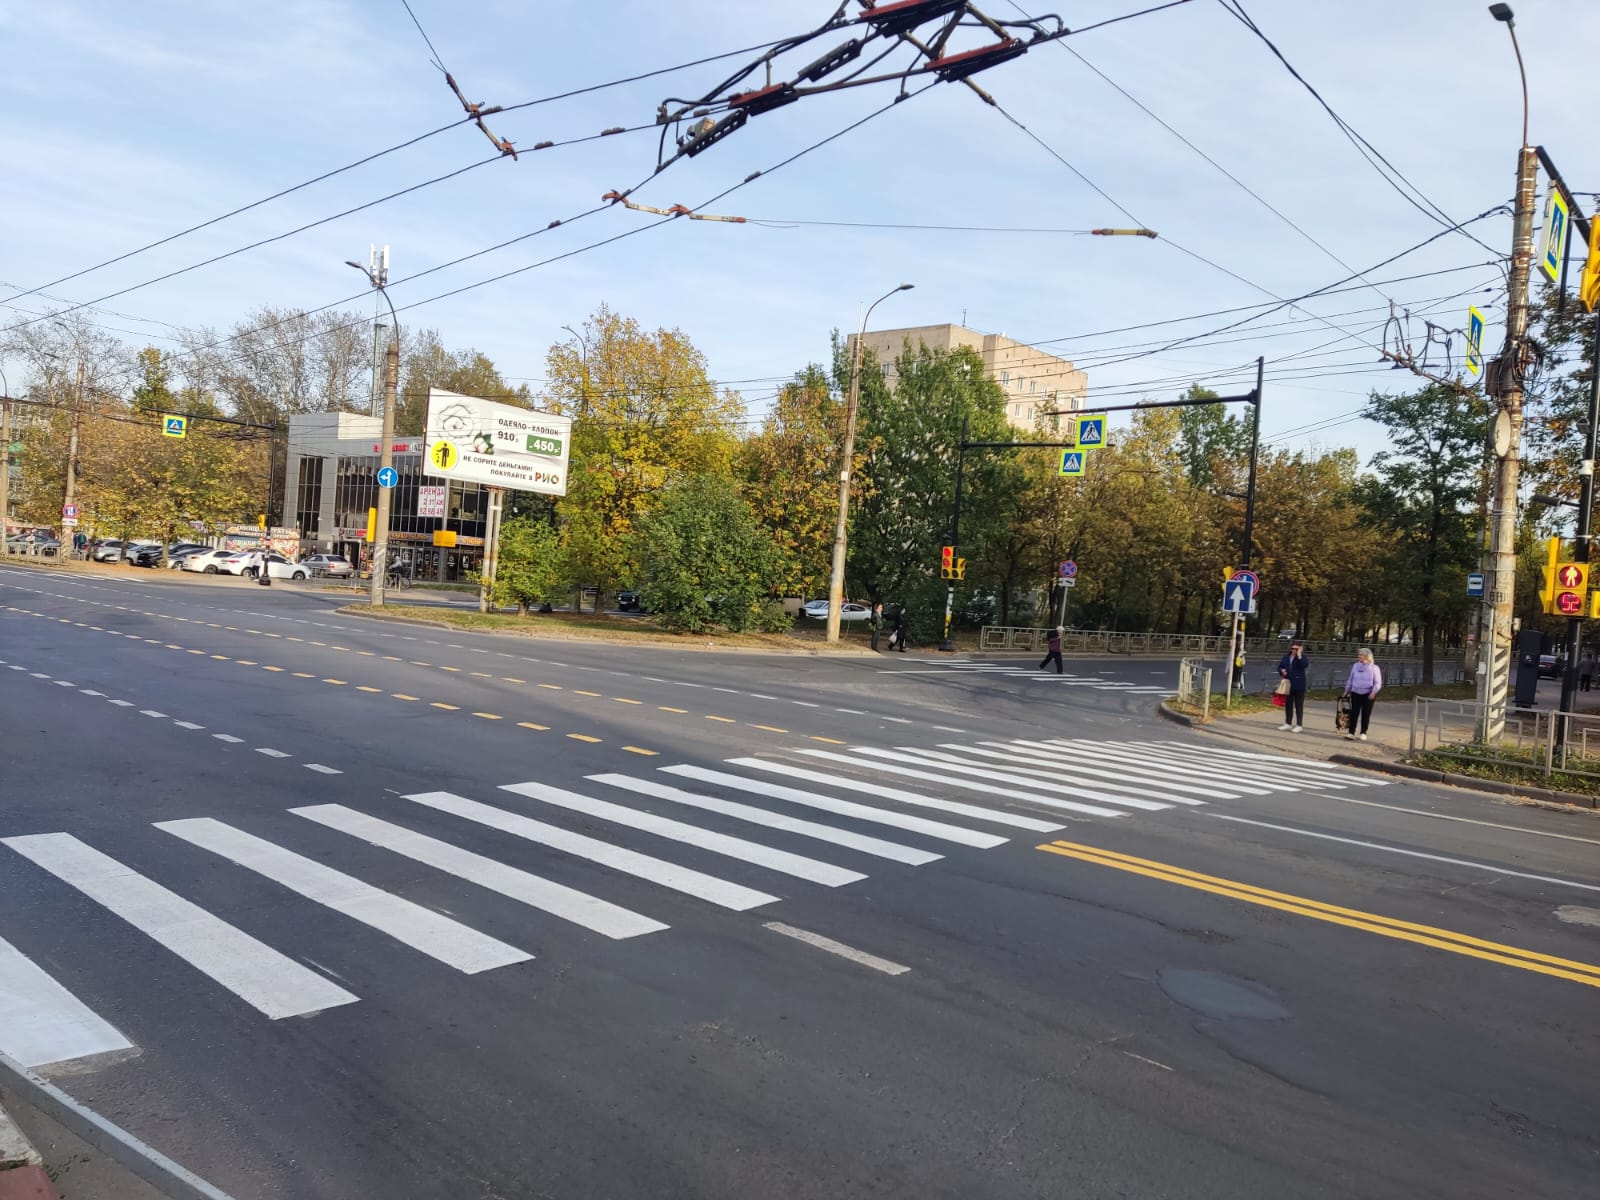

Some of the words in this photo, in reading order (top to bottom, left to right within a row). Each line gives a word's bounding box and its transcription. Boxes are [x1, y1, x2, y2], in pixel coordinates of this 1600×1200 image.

[473, 457, 497, 466] СОРИТЕ
[490, 469, 527, 480] ПОКУПАЙТЕ
[535, 471, 560, 485] РИО
[420, 487, 445, 496] АРЕНДА
